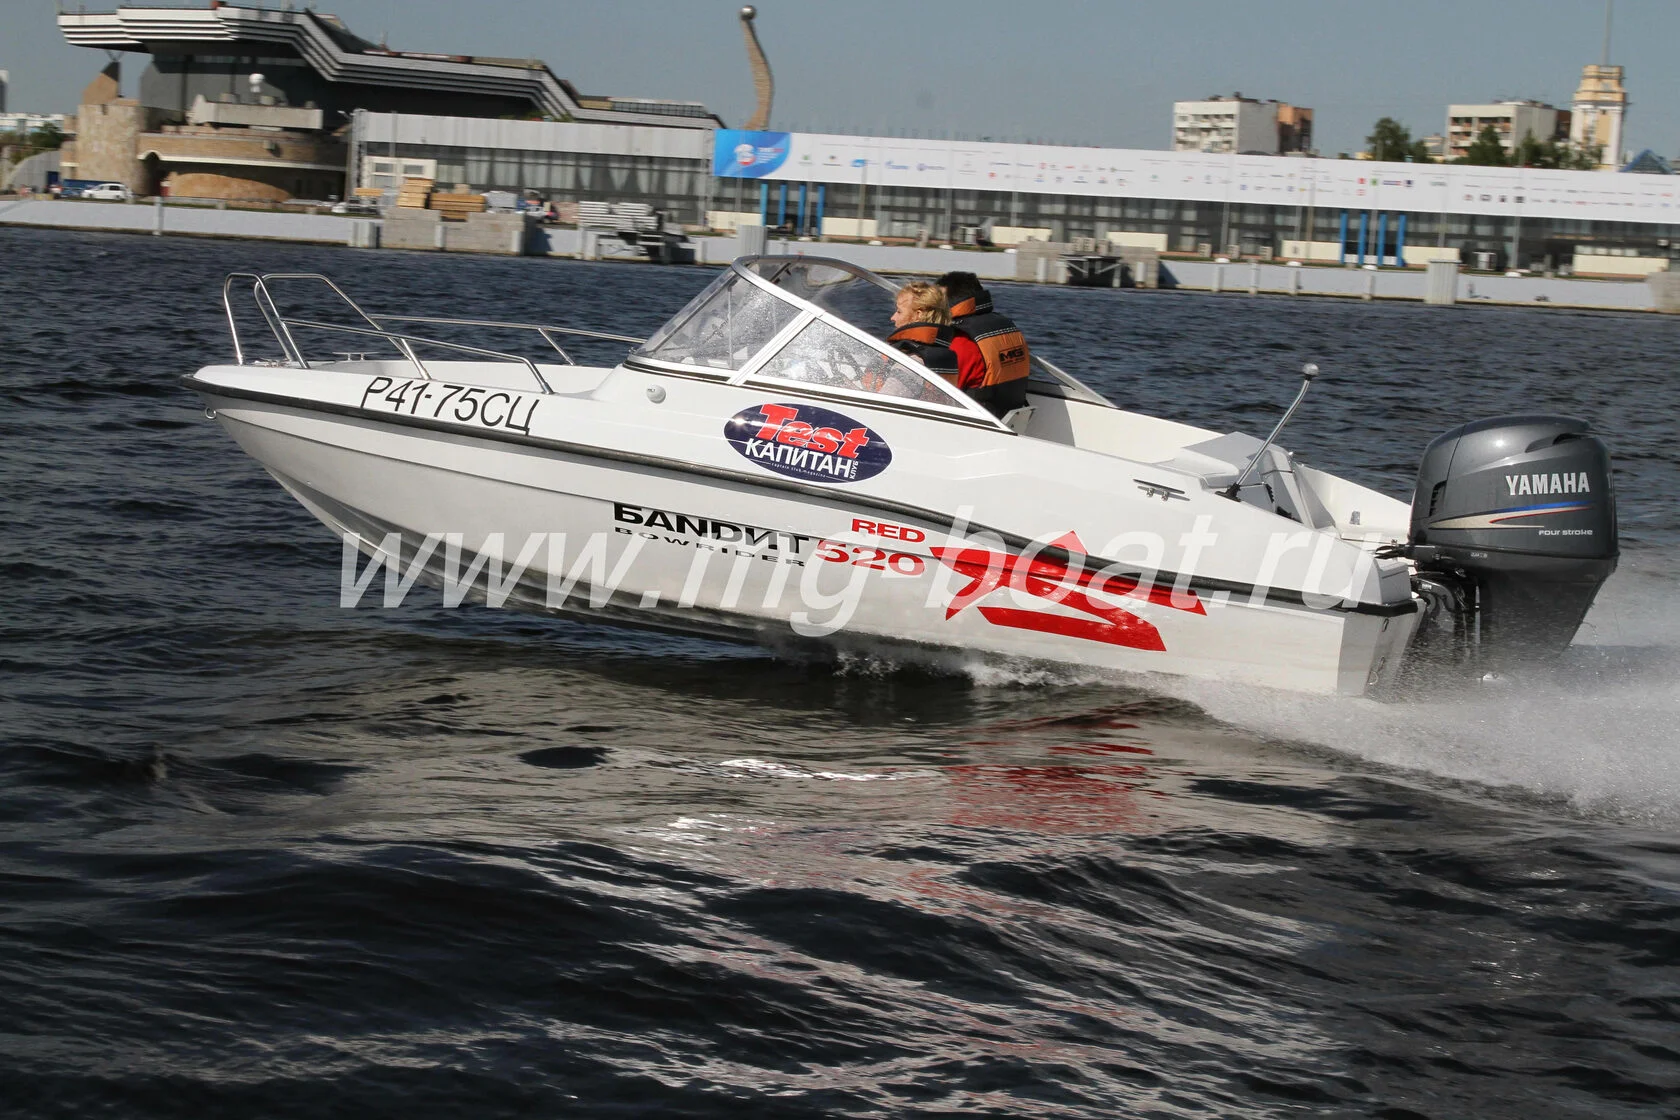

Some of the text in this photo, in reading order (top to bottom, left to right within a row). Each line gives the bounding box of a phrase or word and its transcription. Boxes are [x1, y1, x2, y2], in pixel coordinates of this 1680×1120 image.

[360, 376, 540, 436] Р41-75СЦ
[755, 403, 870, 459] Test
[745, 438, 852, 478] КАПИТАН
[849, 460, 859, 480] КЛУБ
[1505, 472, 1591, 496] YAMAHA
[614, 526, 806, 567] BOWRIDER
[851, 518, 926, 543] RED
[815, 539, 926, 577] 520
